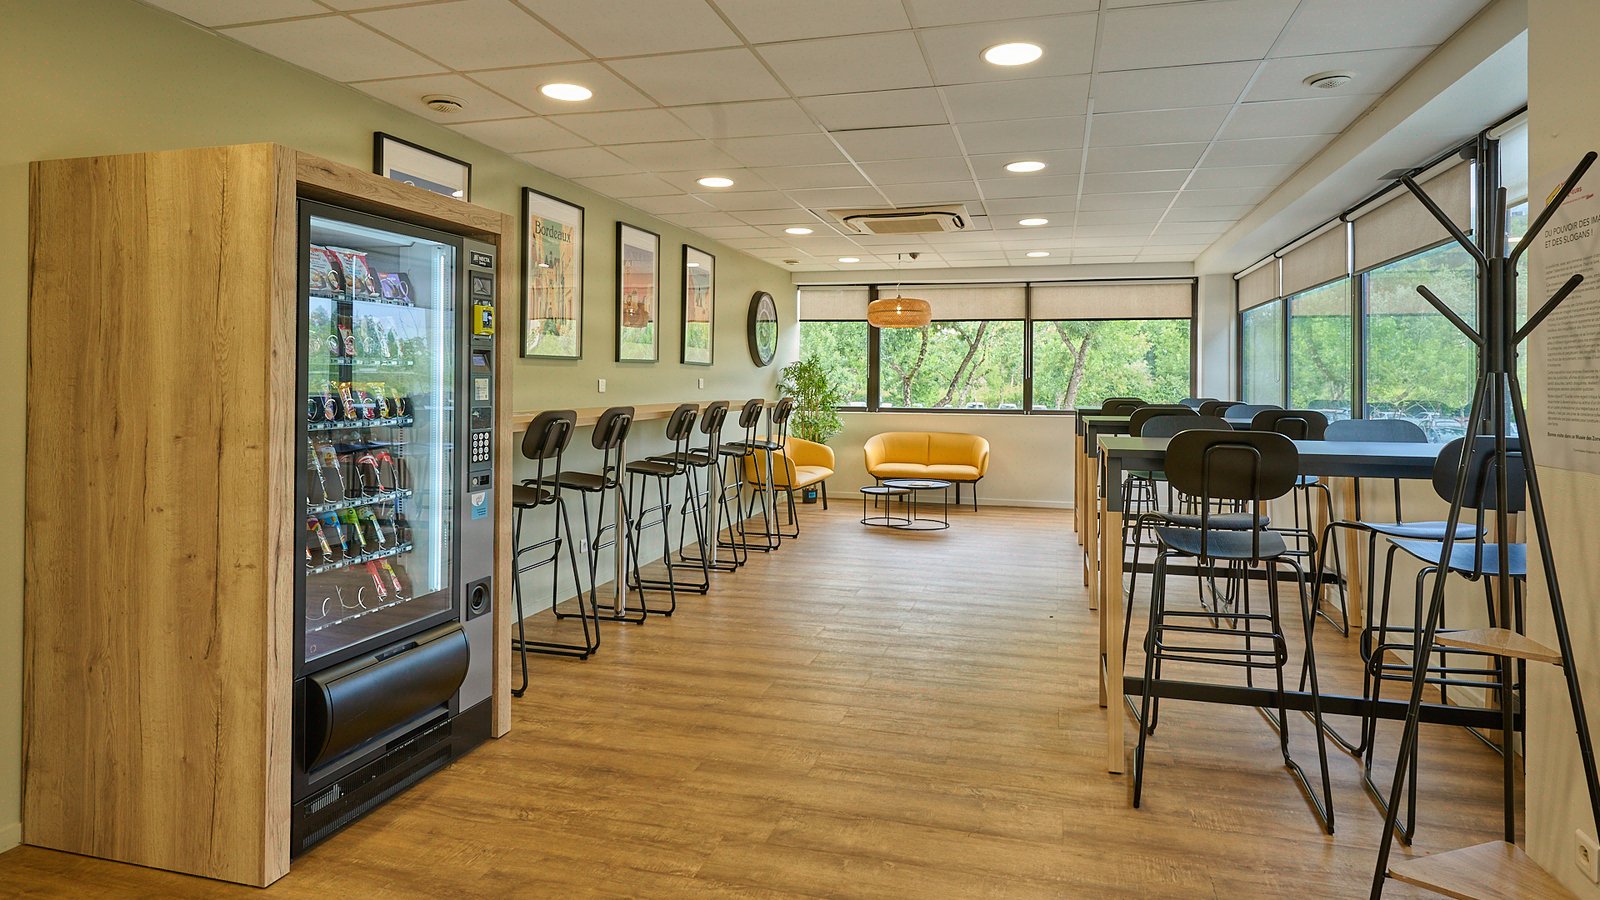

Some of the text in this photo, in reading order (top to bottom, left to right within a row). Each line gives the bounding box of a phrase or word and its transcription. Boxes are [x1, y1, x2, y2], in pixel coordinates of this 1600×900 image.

[535, 220, 571, 243] Bordeaux
[1545, 229, 1552, 238] DU
[1553, 221, 1578, 236] POUVOIR
[1578, 217, 1590, 228] DES
[1545, 240, 1551, 249] ET
[1552, 236, 1563, 247] DES
[1563, 229, 1590, 244] SLOGANS
